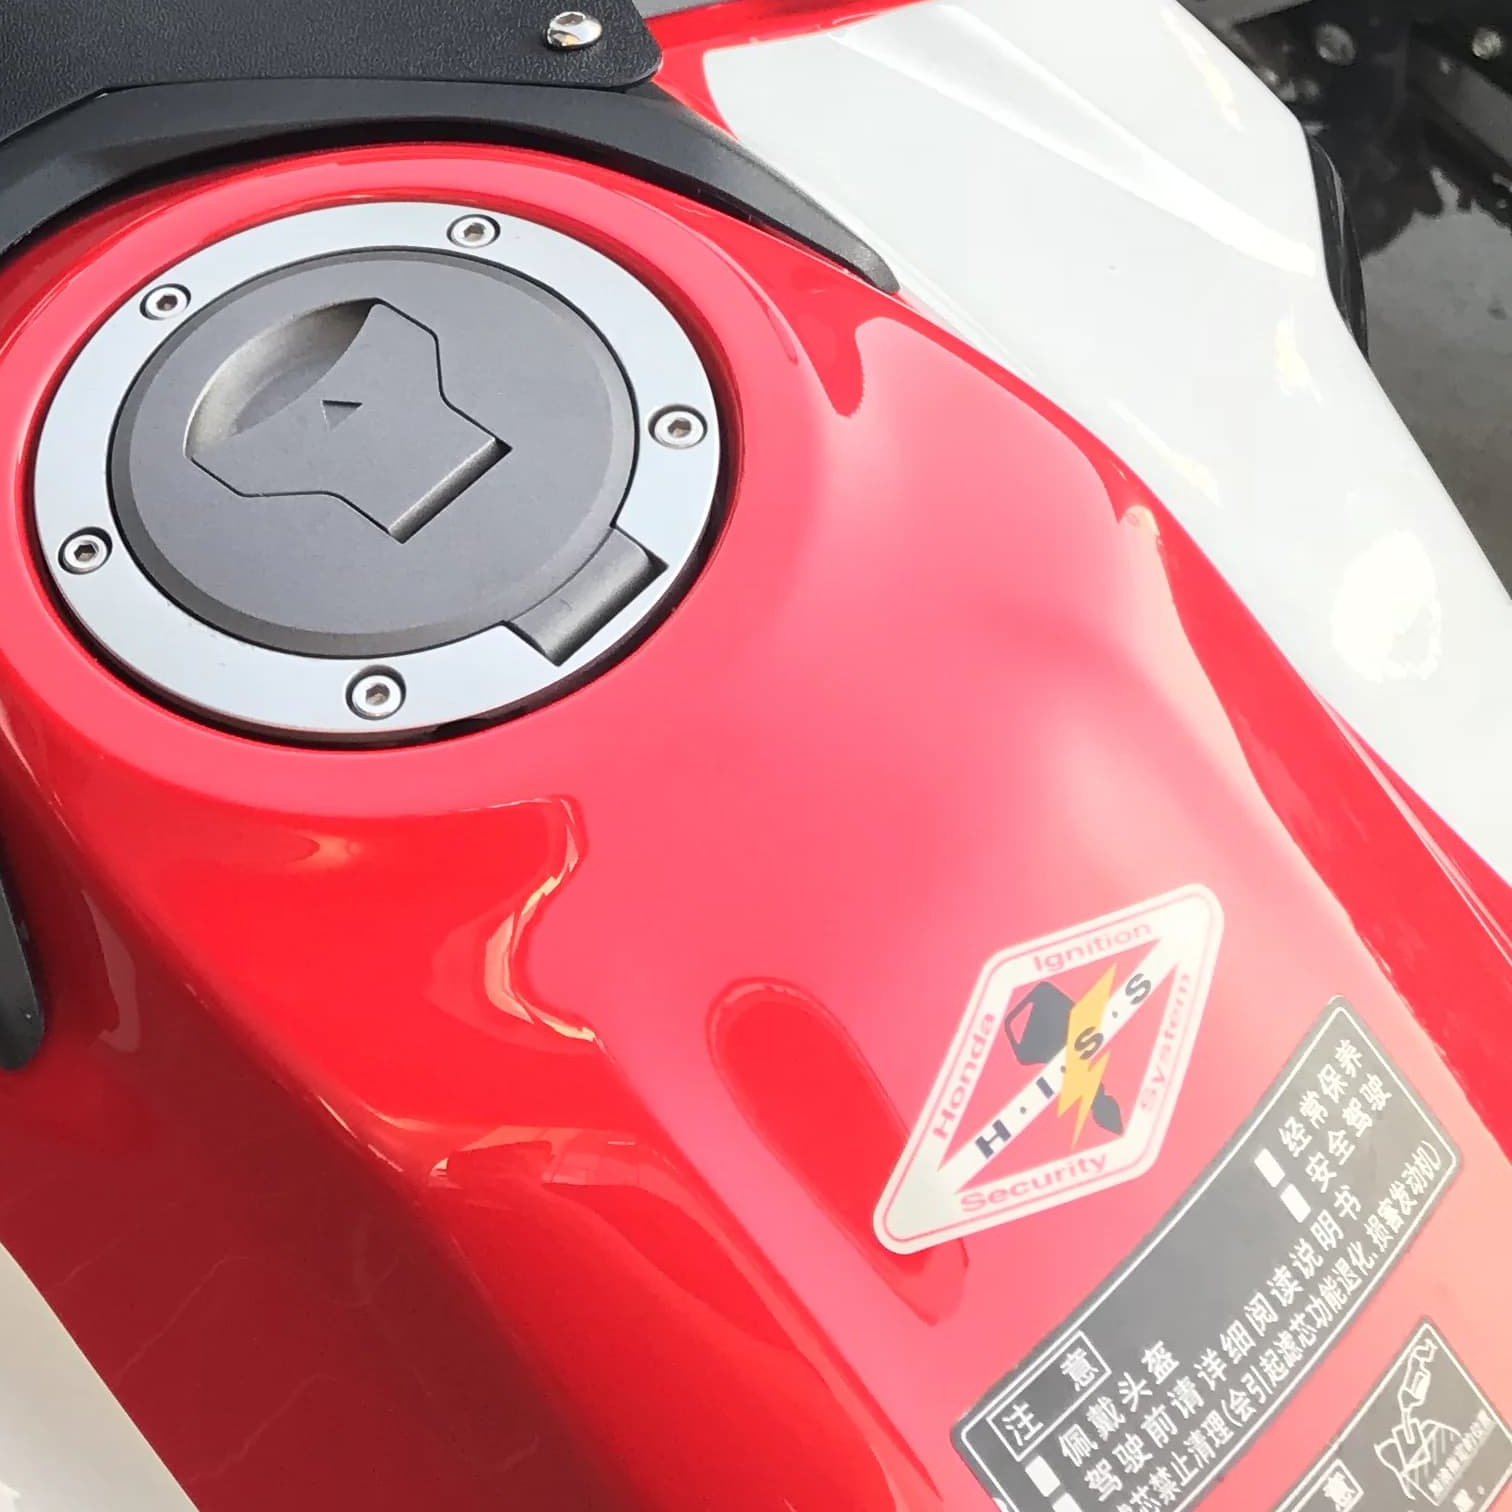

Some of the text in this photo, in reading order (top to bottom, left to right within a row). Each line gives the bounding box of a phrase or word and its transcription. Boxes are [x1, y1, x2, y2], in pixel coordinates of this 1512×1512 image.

[1032, 922, 1153, 975] Ignition
[931, 1012, 995, 1142] Honda
[1140, 971, 1191, 1114] System
[1277, 1039, 1364, 1158] 经常保养
[959, 1152, 1109, 1214] Security
[1304, 1072, 1393, 1194] 安全驾驶
[1001, 1346, 1100, 1447] 注意
[1057, 1339, 1181, 1468] 佩戴头盔
[1083, 1184, 1362, 1503] 驾驶前请详细阅读说明书
